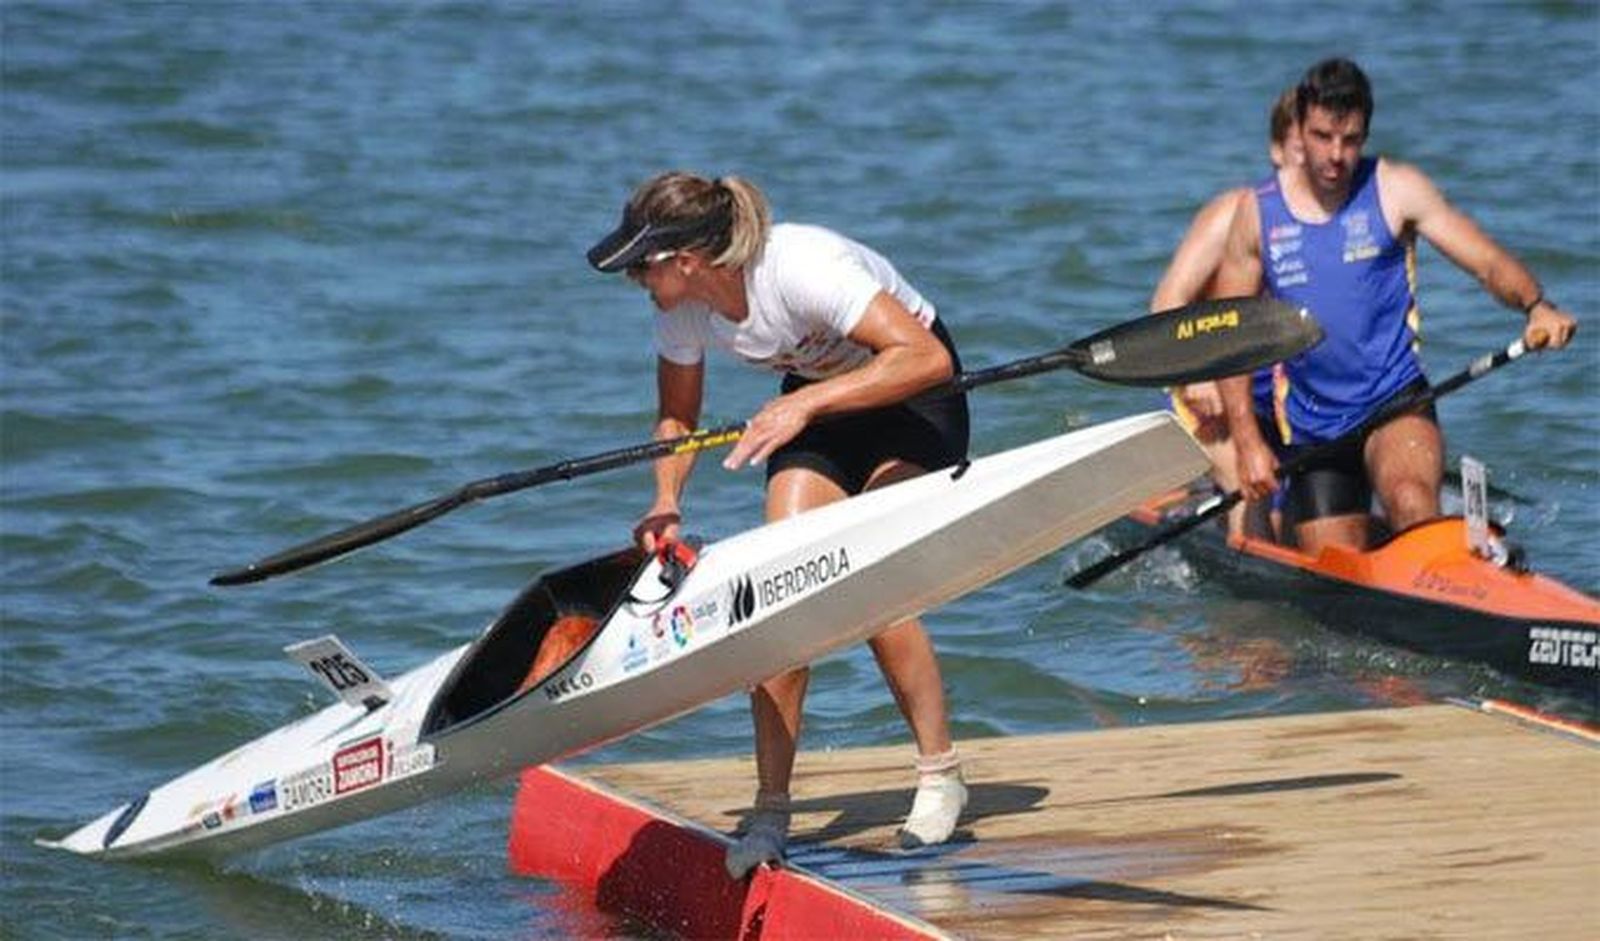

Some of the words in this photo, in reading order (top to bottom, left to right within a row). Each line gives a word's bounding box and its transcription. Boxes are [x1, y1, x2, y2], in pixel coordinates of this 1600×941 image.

[759, 547, 849, 608] IBERDROLA
[309, 653, 370, 691] 225
[544, 672, 594, 701] NELO
